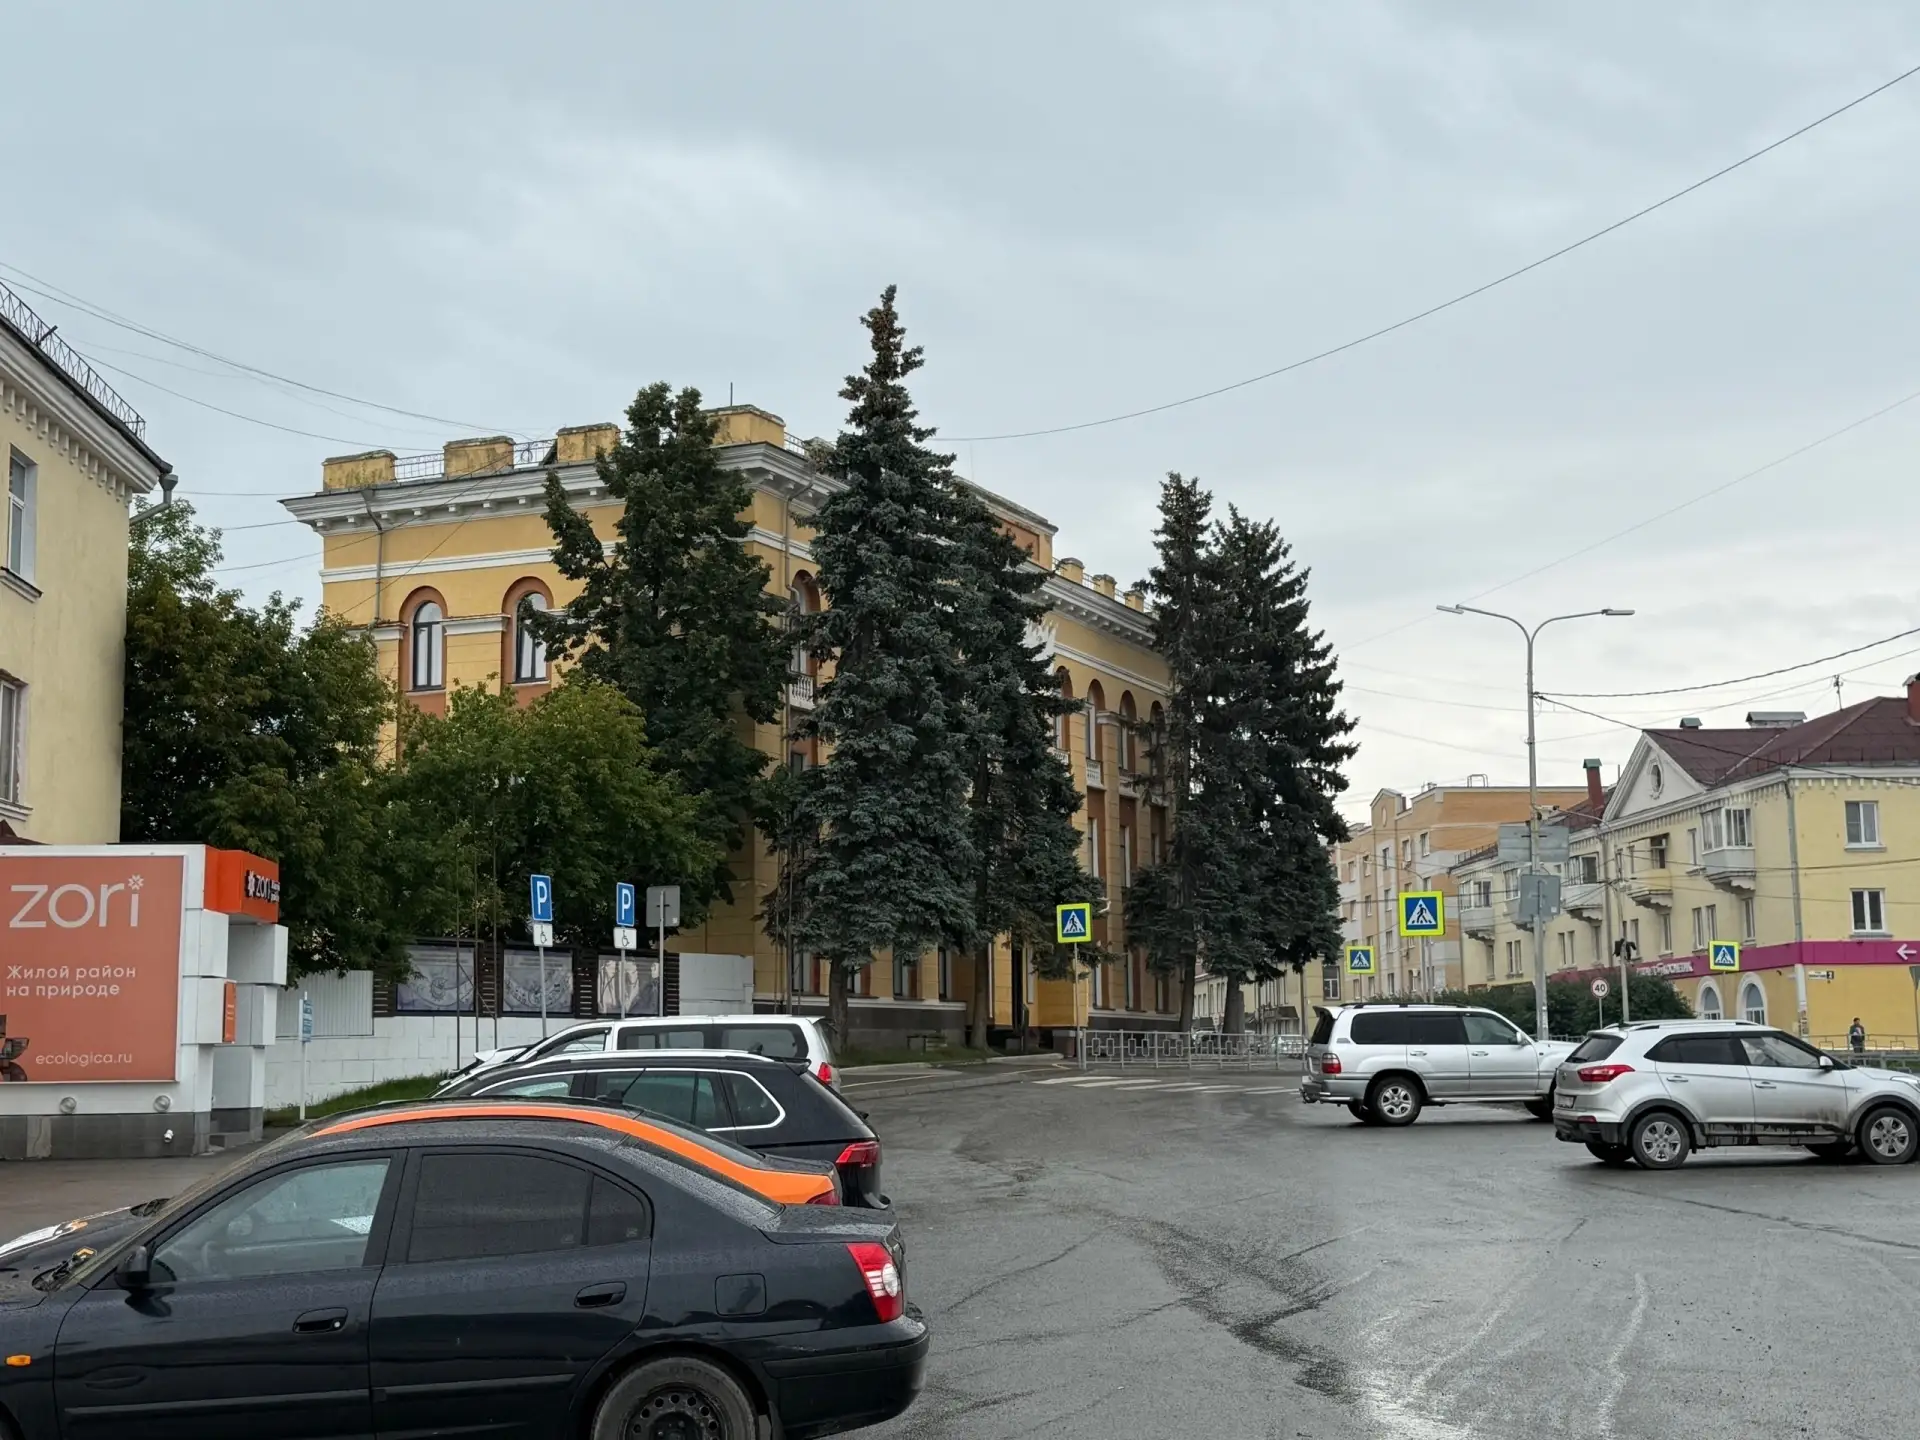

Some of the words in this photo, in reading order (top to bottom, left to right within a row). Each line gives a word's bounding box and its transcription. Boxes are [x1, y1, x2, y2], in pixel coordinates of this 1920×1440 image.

[9, 874, 144, 928] zori
[536, 881, 548, 915] P
[621, 888, 632, 920] P
[6, 965, 70, 979] Жилой
[75, 965, 137, 981] район
[6, 985, 30, 997] на
[36, 984, 120, 999] природе
[1594, 983, 1606, 992] 40
[35, 1051, 133, 1067] ecologica.ru
